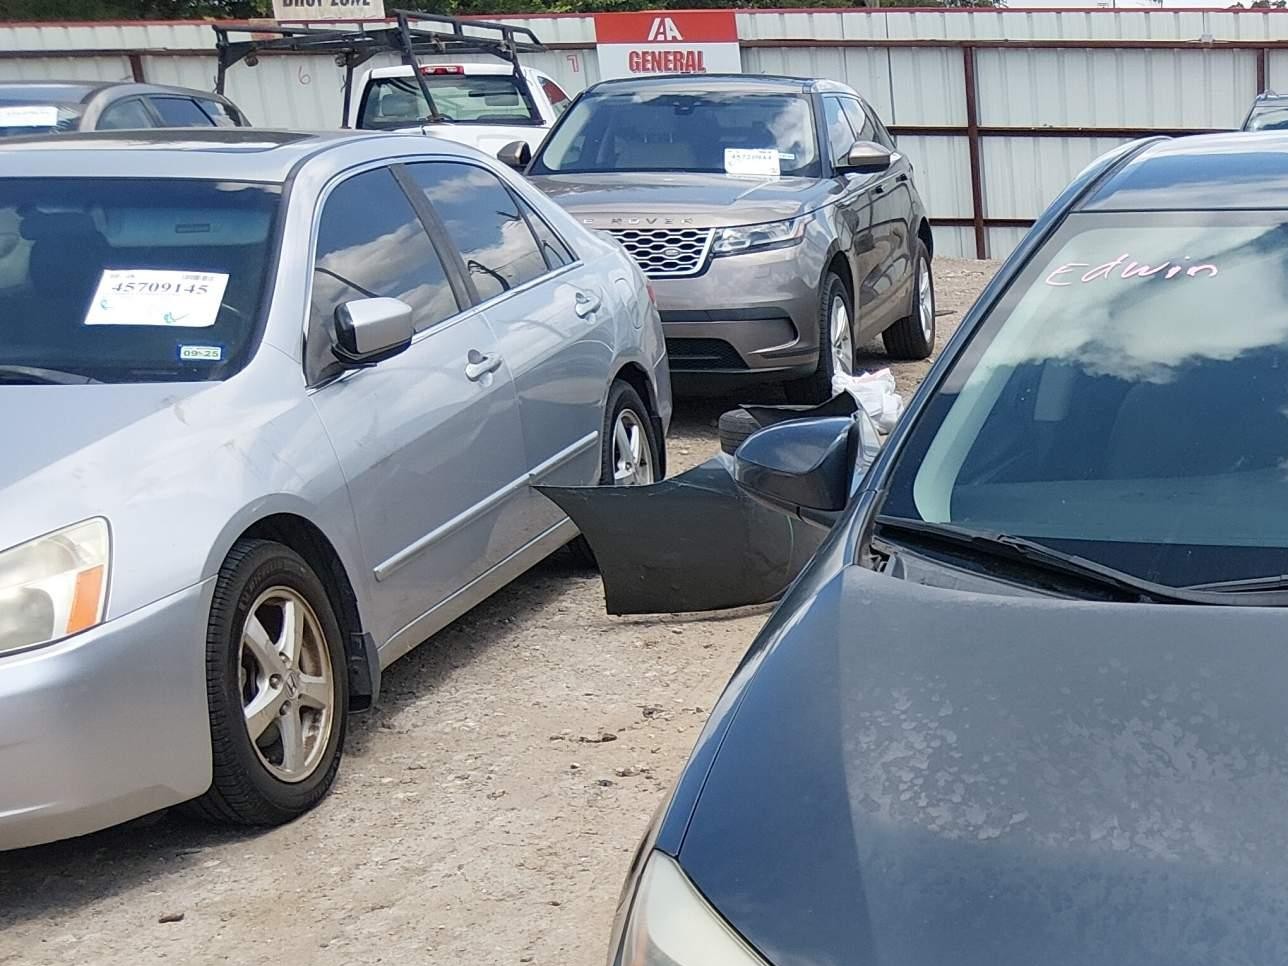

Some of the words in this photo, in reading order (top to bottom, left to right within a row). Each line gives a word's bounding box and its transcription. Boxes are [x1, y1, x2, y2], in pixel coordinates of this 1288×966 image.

[629, 51, 706, 73] GENERAL
[298, 65, 311, 85] 6
[611, 217, 693, 225] ROVER
[1046, 253, 1218, 286] Edwin
[112, 282, 208, 294] 45709145
